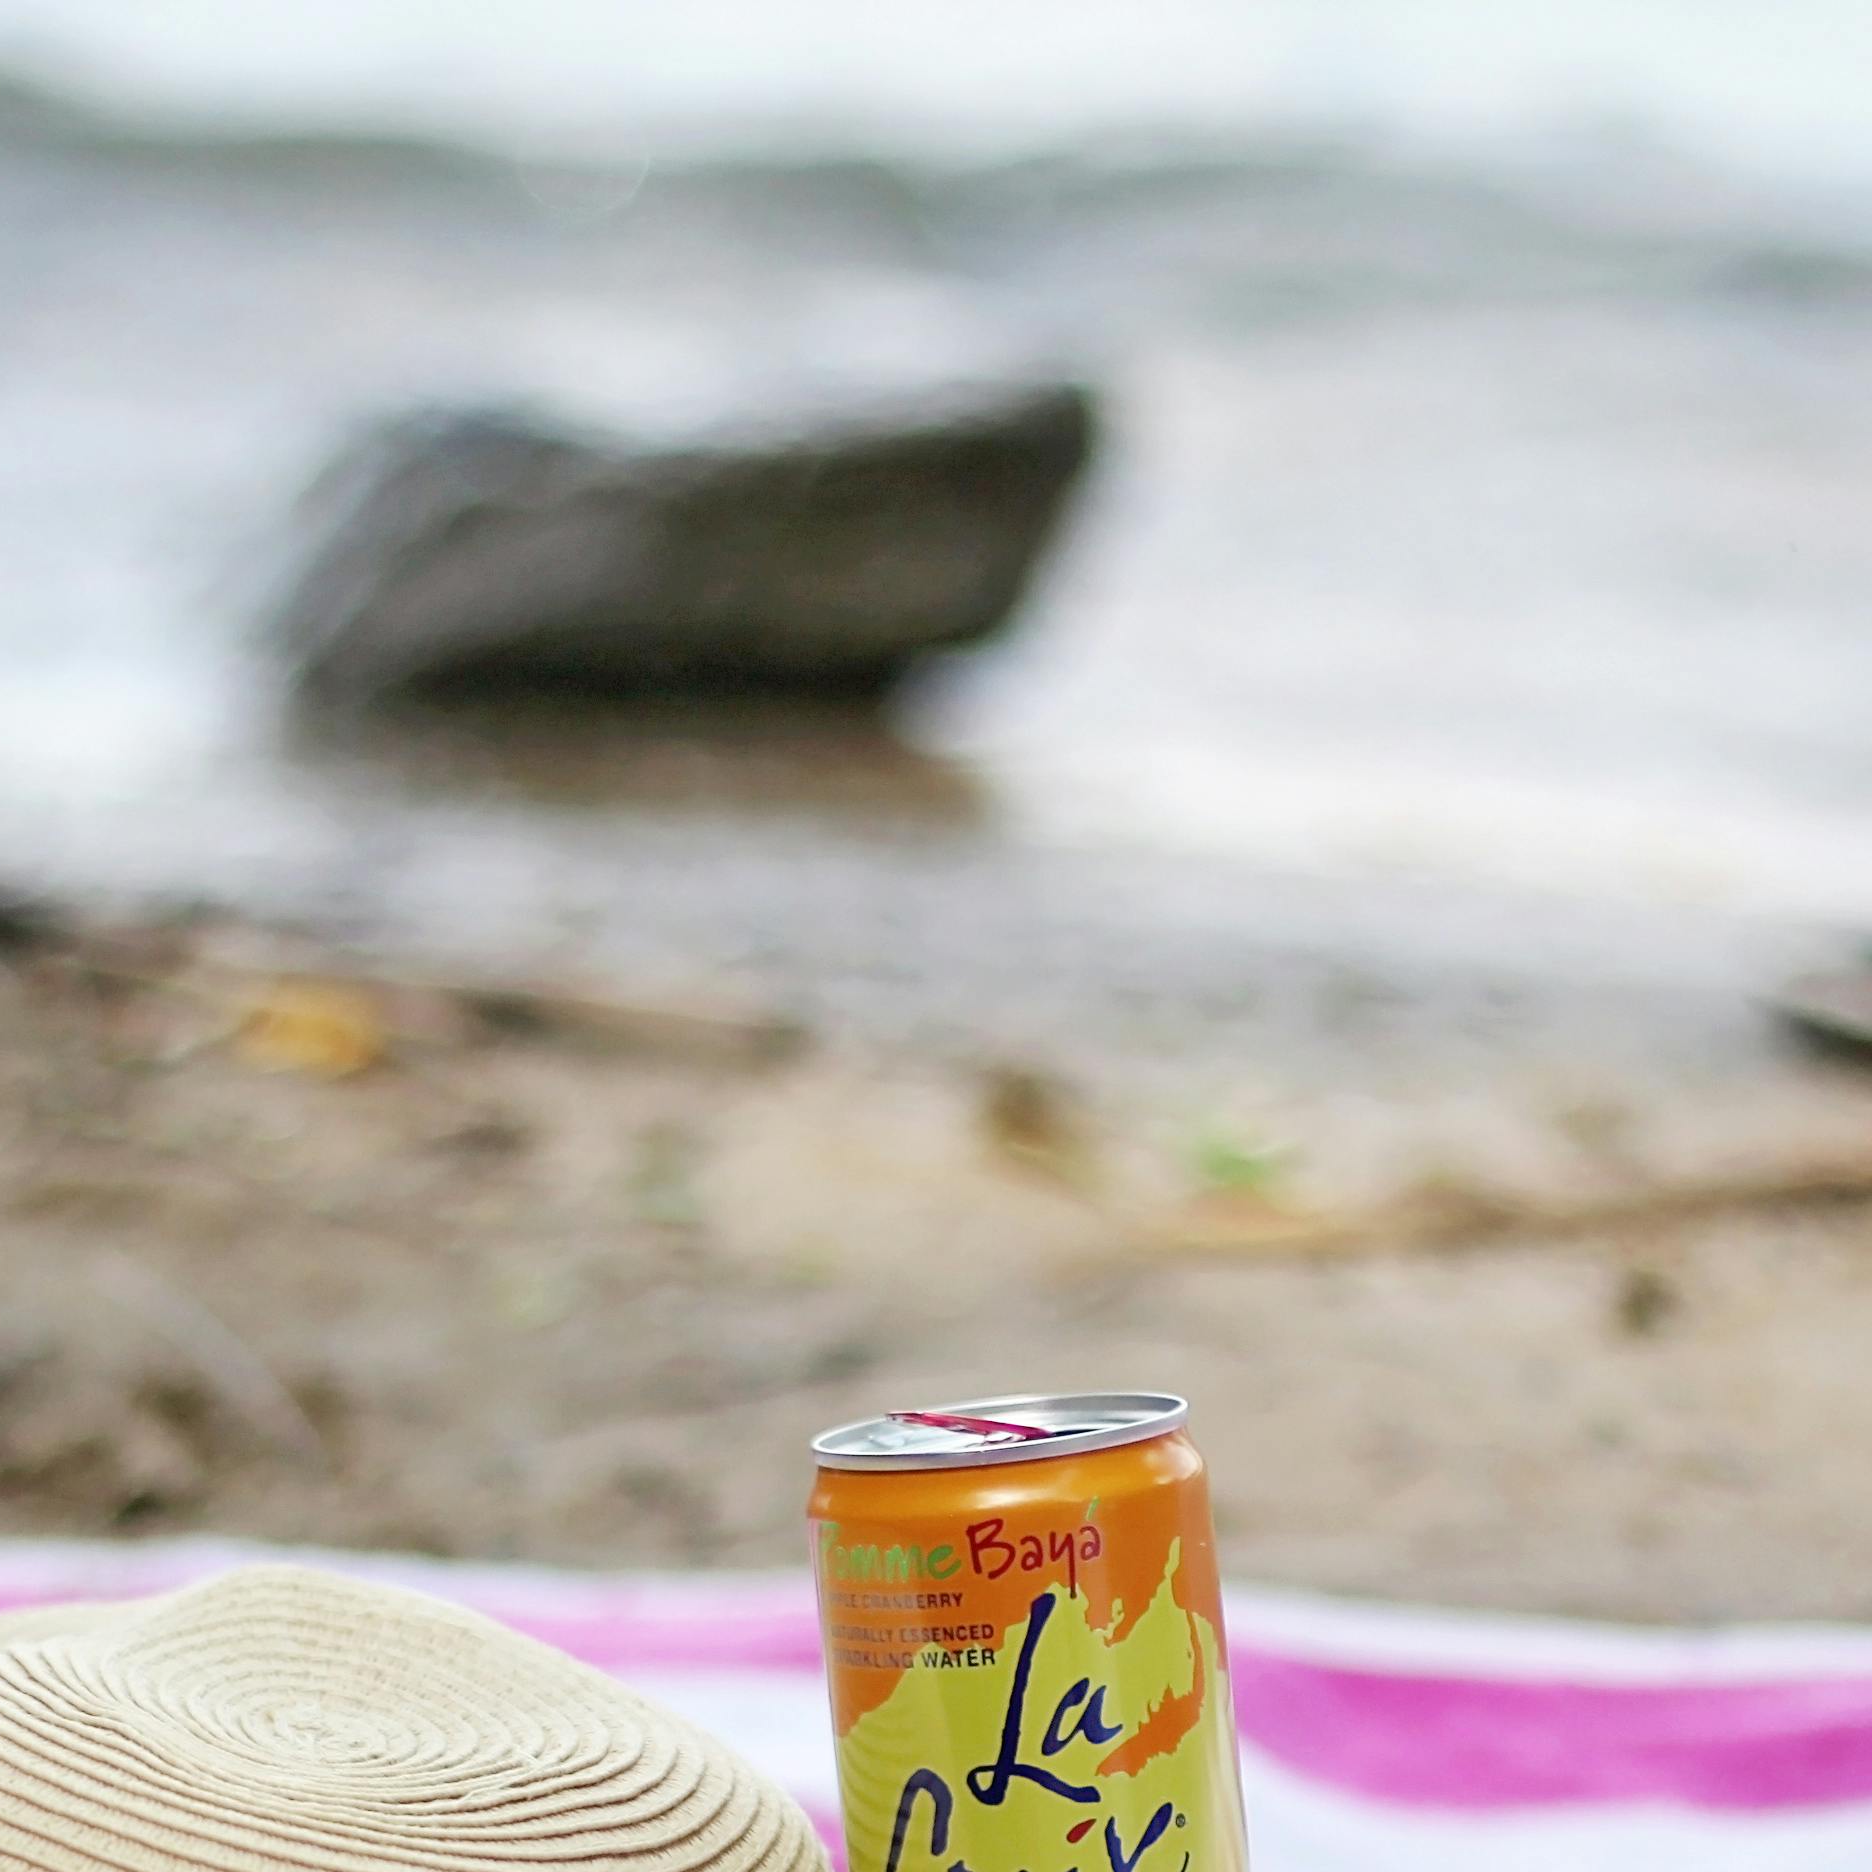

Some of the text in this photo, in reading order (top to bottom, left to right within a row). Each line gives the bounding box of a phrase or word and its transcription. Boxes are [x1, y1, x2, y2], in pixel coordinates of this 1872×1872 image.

[863, 1593, 963, 1610] CRANBERRY
[900, 1624, 995, 1643] ESSENCED
[921, 1648, 996, 1669] WATER
[966, 1593, 1123, 1806] La
